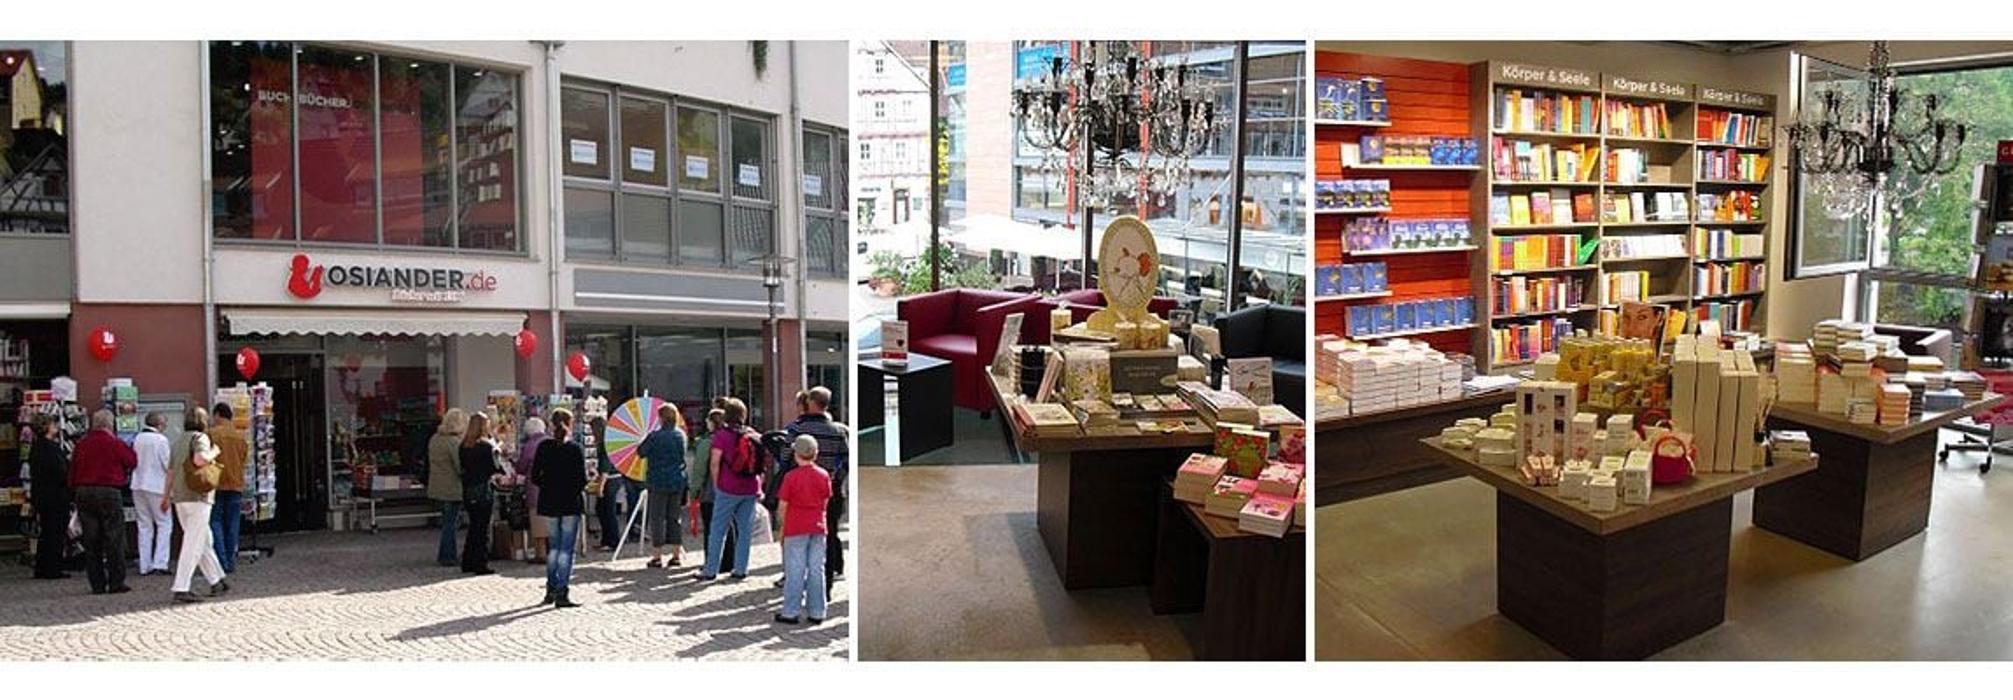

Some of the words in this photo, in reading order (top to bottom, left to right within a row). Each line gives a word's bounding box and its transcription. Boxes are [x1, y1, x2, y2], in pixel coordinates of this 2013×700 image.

[1502, 64, 1546, 83] Körper
[1547, 69, 1557, 82] &
[1559, 70, 1591, 86] Seele
[328, 265, 497, 291] OSIANDER.de
